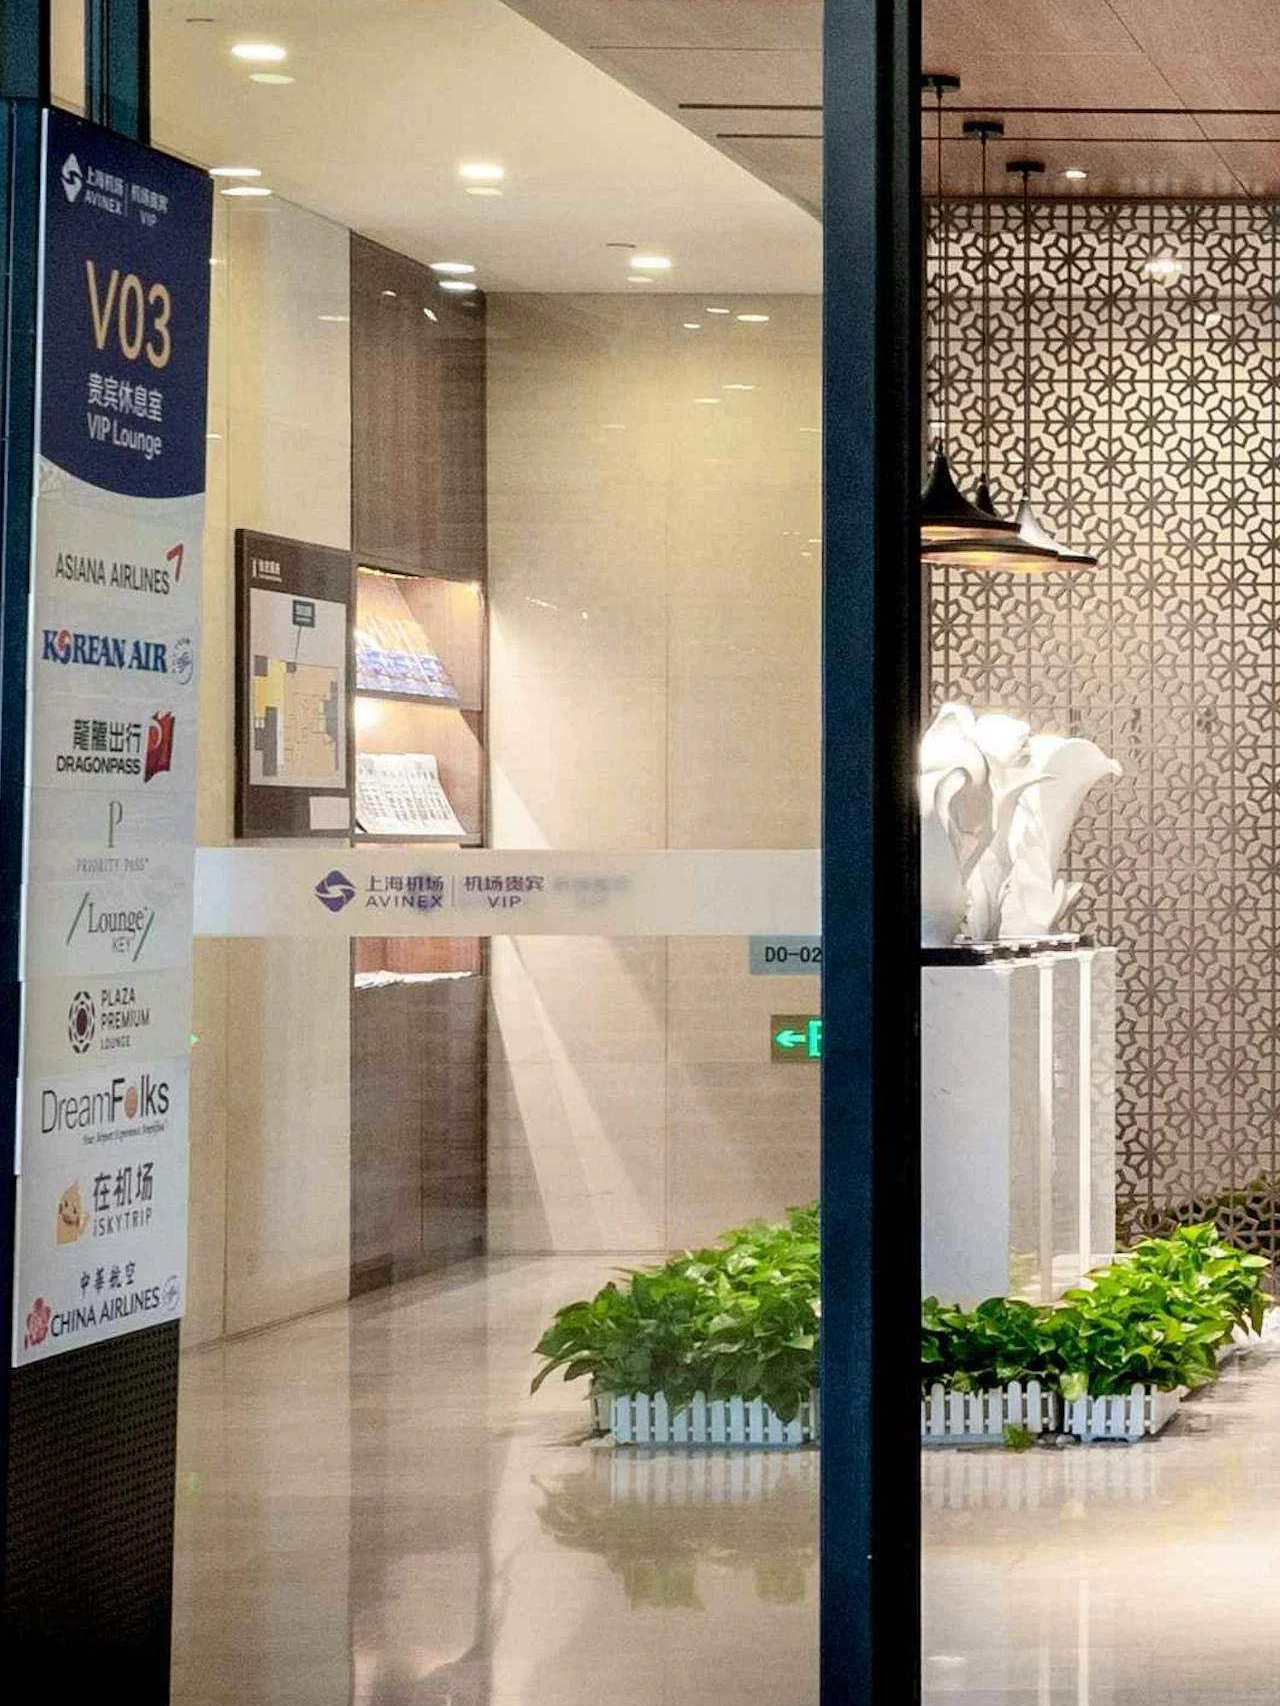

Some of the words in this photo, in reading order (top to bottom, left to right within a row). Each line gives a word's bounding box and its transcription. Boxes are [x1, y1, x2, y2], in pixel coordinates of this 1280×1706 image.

[86, 260, 171, 369] V03
[87, 372, 163, 422] 贵宾休息室
[87, 412, 111, 441] VIP
[112, 420, 162, 460] Lounge
[56, 553, 106, 586] ASIANA
[110, 563, 170, 595] AIRLINES
[43, 630, 126, 669] KOREAN
[128, 640, 168, 674] AIR
[57, 755, 140, 775] DRAGONPASS
[77, 859, 120, 873] PRIORITY
[365, 875, 445, 892] 上海机场
[463, 875, 545, 893] 机场贵宾
[87, 903, 144, 936] Lounge
[366, 894, 444, 909] AVINEX
[488, 895, 522, 909] VIP
[101, 988, 136, 1006] PLAZA
[101, 1008, 150, 1030] PREMIUM
[100, 1035, 131, 1050] LOUNGE
[41, 1073, 170, 1134] DreamFolks
[93, 1162, 154, 1213] 在机场
[50, 1305, 97, 1337] CHINA
[99, 1286, 161, 1323] AIRLINES
